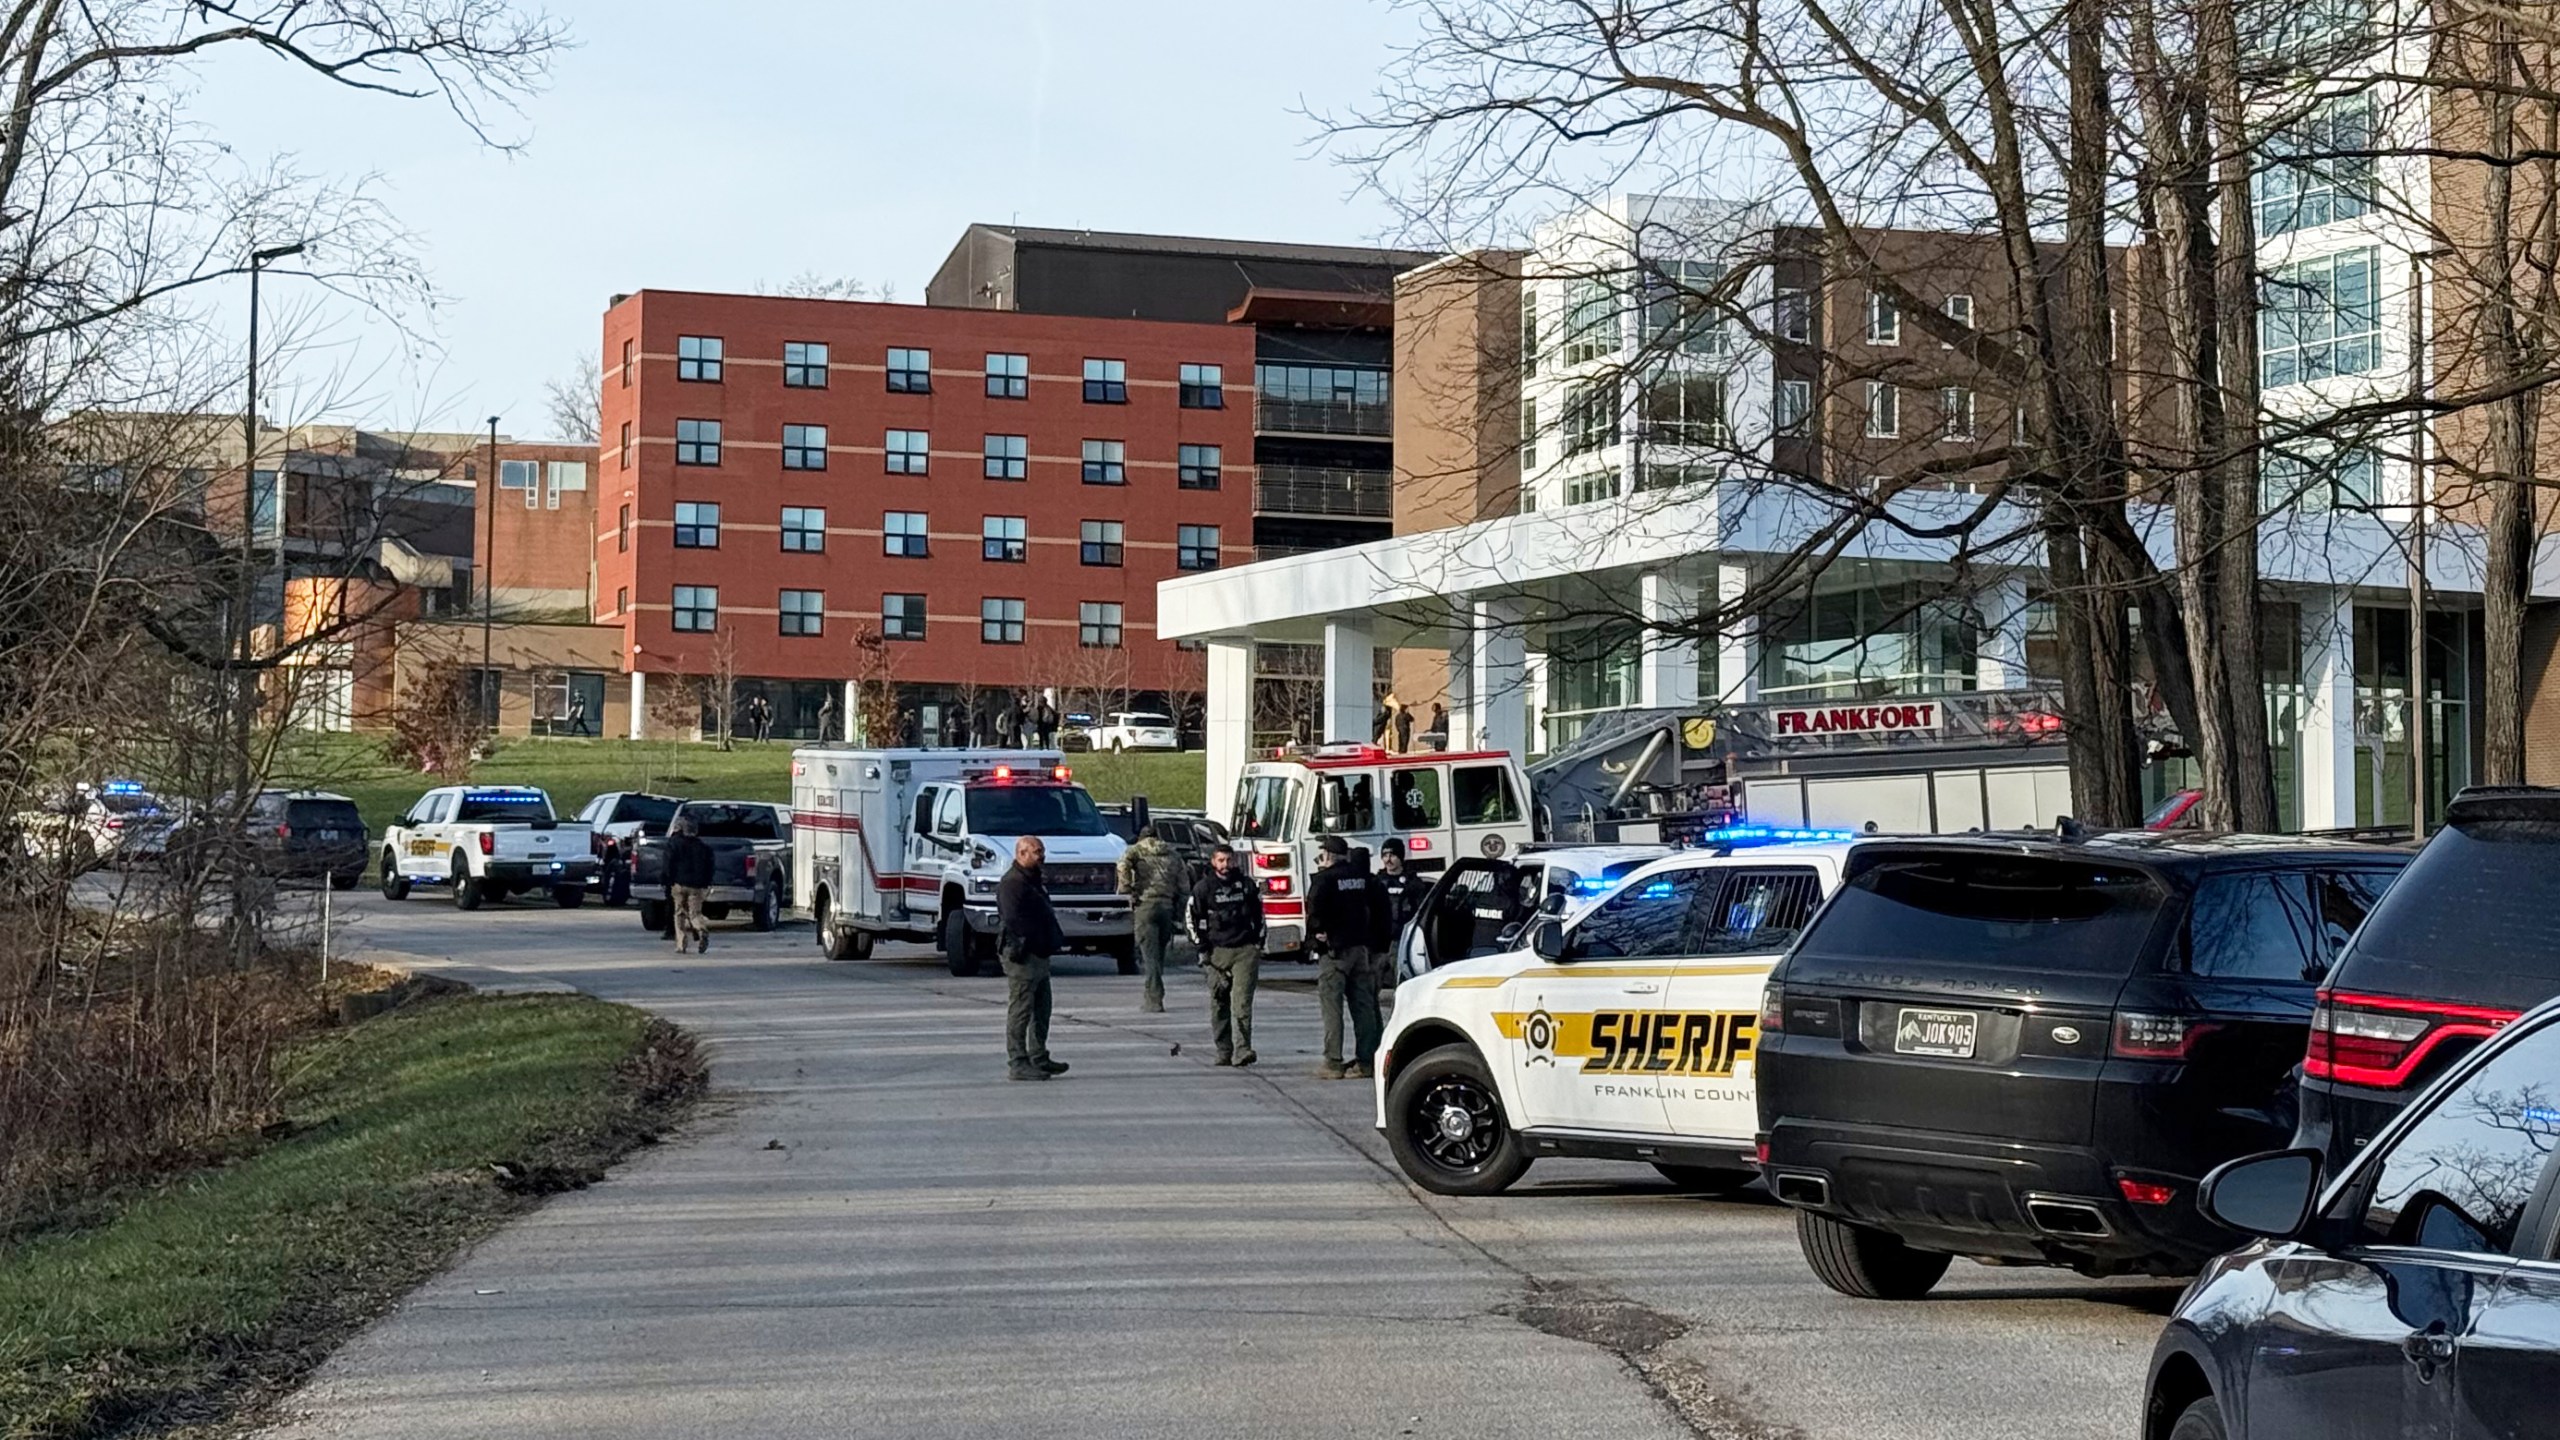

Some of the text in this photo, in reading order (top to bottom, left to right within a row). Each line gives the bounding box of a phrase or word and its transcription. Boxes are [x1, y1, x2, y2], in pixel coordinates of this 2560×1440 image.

[1777, 705, 1934, 734] FRANKFORT
[1942, 979, 2042, 996] ROVER
[1917, 1012, 1958, 1023] KENTUCKY
[1583, 1013, 1757, 1073] SHERIF
[1594, 1085, 1756, 1101] FRANKLIN COUN
